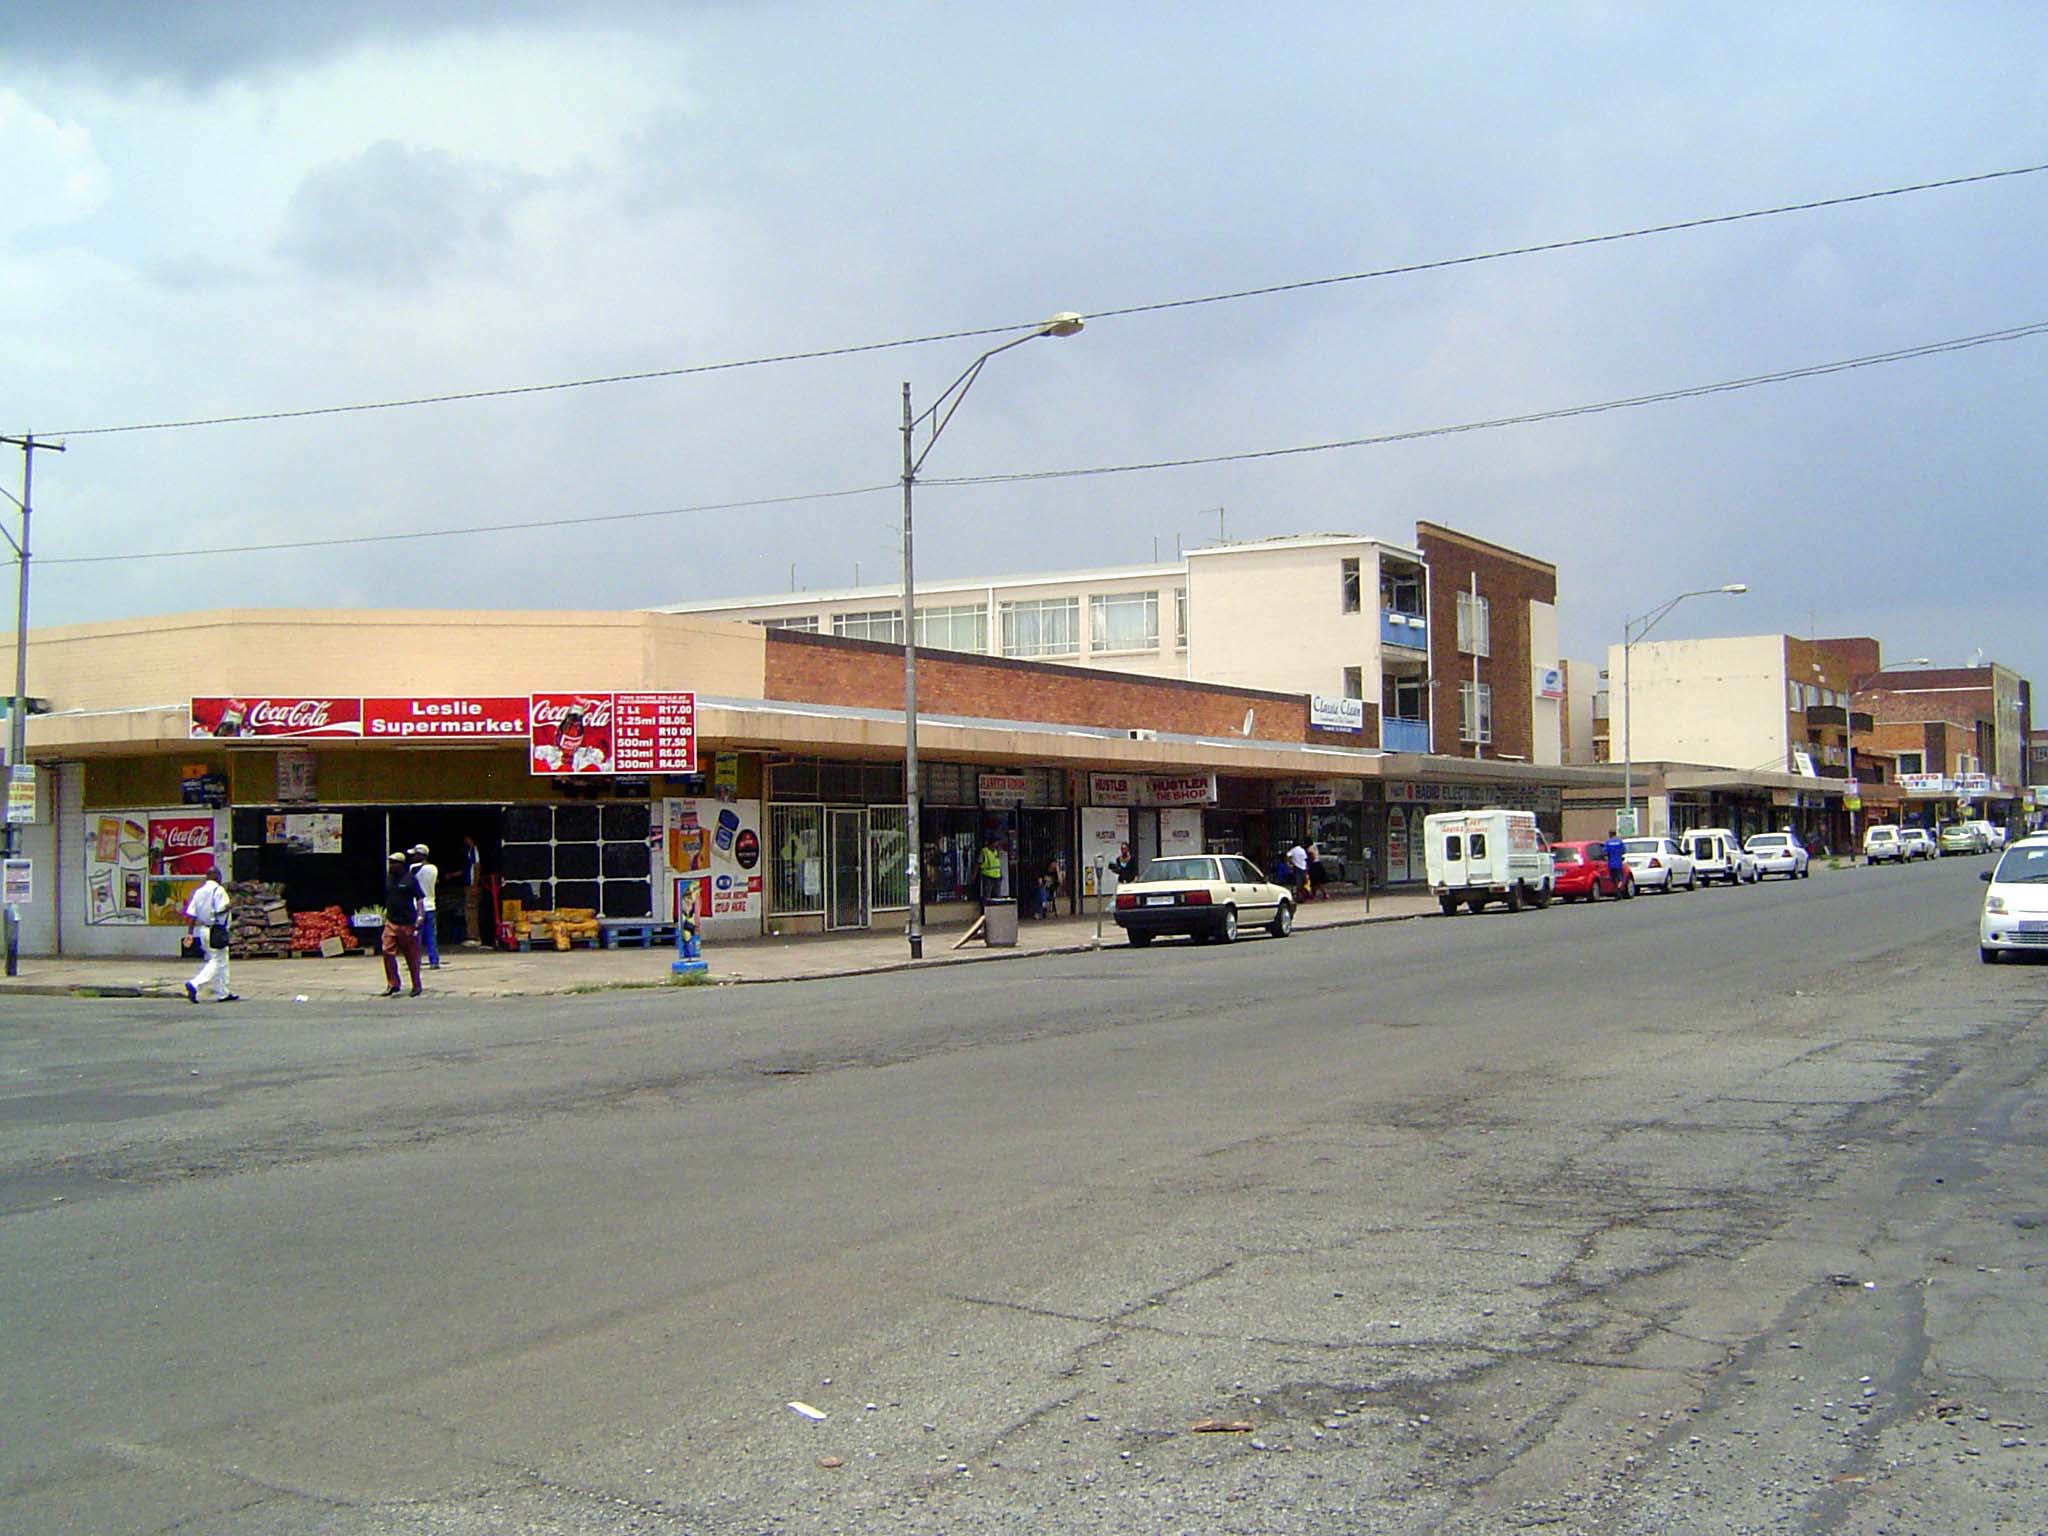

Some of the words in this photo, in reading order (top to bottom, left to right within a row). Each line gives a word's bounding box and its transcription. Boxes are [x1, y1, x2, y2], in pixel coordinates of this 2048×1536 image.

[250, 700, 331, 727] Coca-Cola
[412, 702, 482, 716] Leslie
[617, 705, 624, 714] 2
[627, 706, 640, 714] Lt
[659, 705, 692, 714] R17.00
[617, 716, 656, 725] 1.25ml
[372, 718, 523, 736] Supermarket
[617, 728, 623, 736] 1
[627, 728, 640, 736] Lt
[617, 738, 653, 747] 500ml
[659, 738, 687, 747] R7.50
[617, 749, 654, 758] 330ml
[617, 760, 654, 768] 300ml
[659, 760, 687, 768] R4.00
[1153, 778, 1208, 791] HUSTLER
[1173, 789, 1207, 800] SHOP
[168, 826, 209, 847] Coca-Cola
